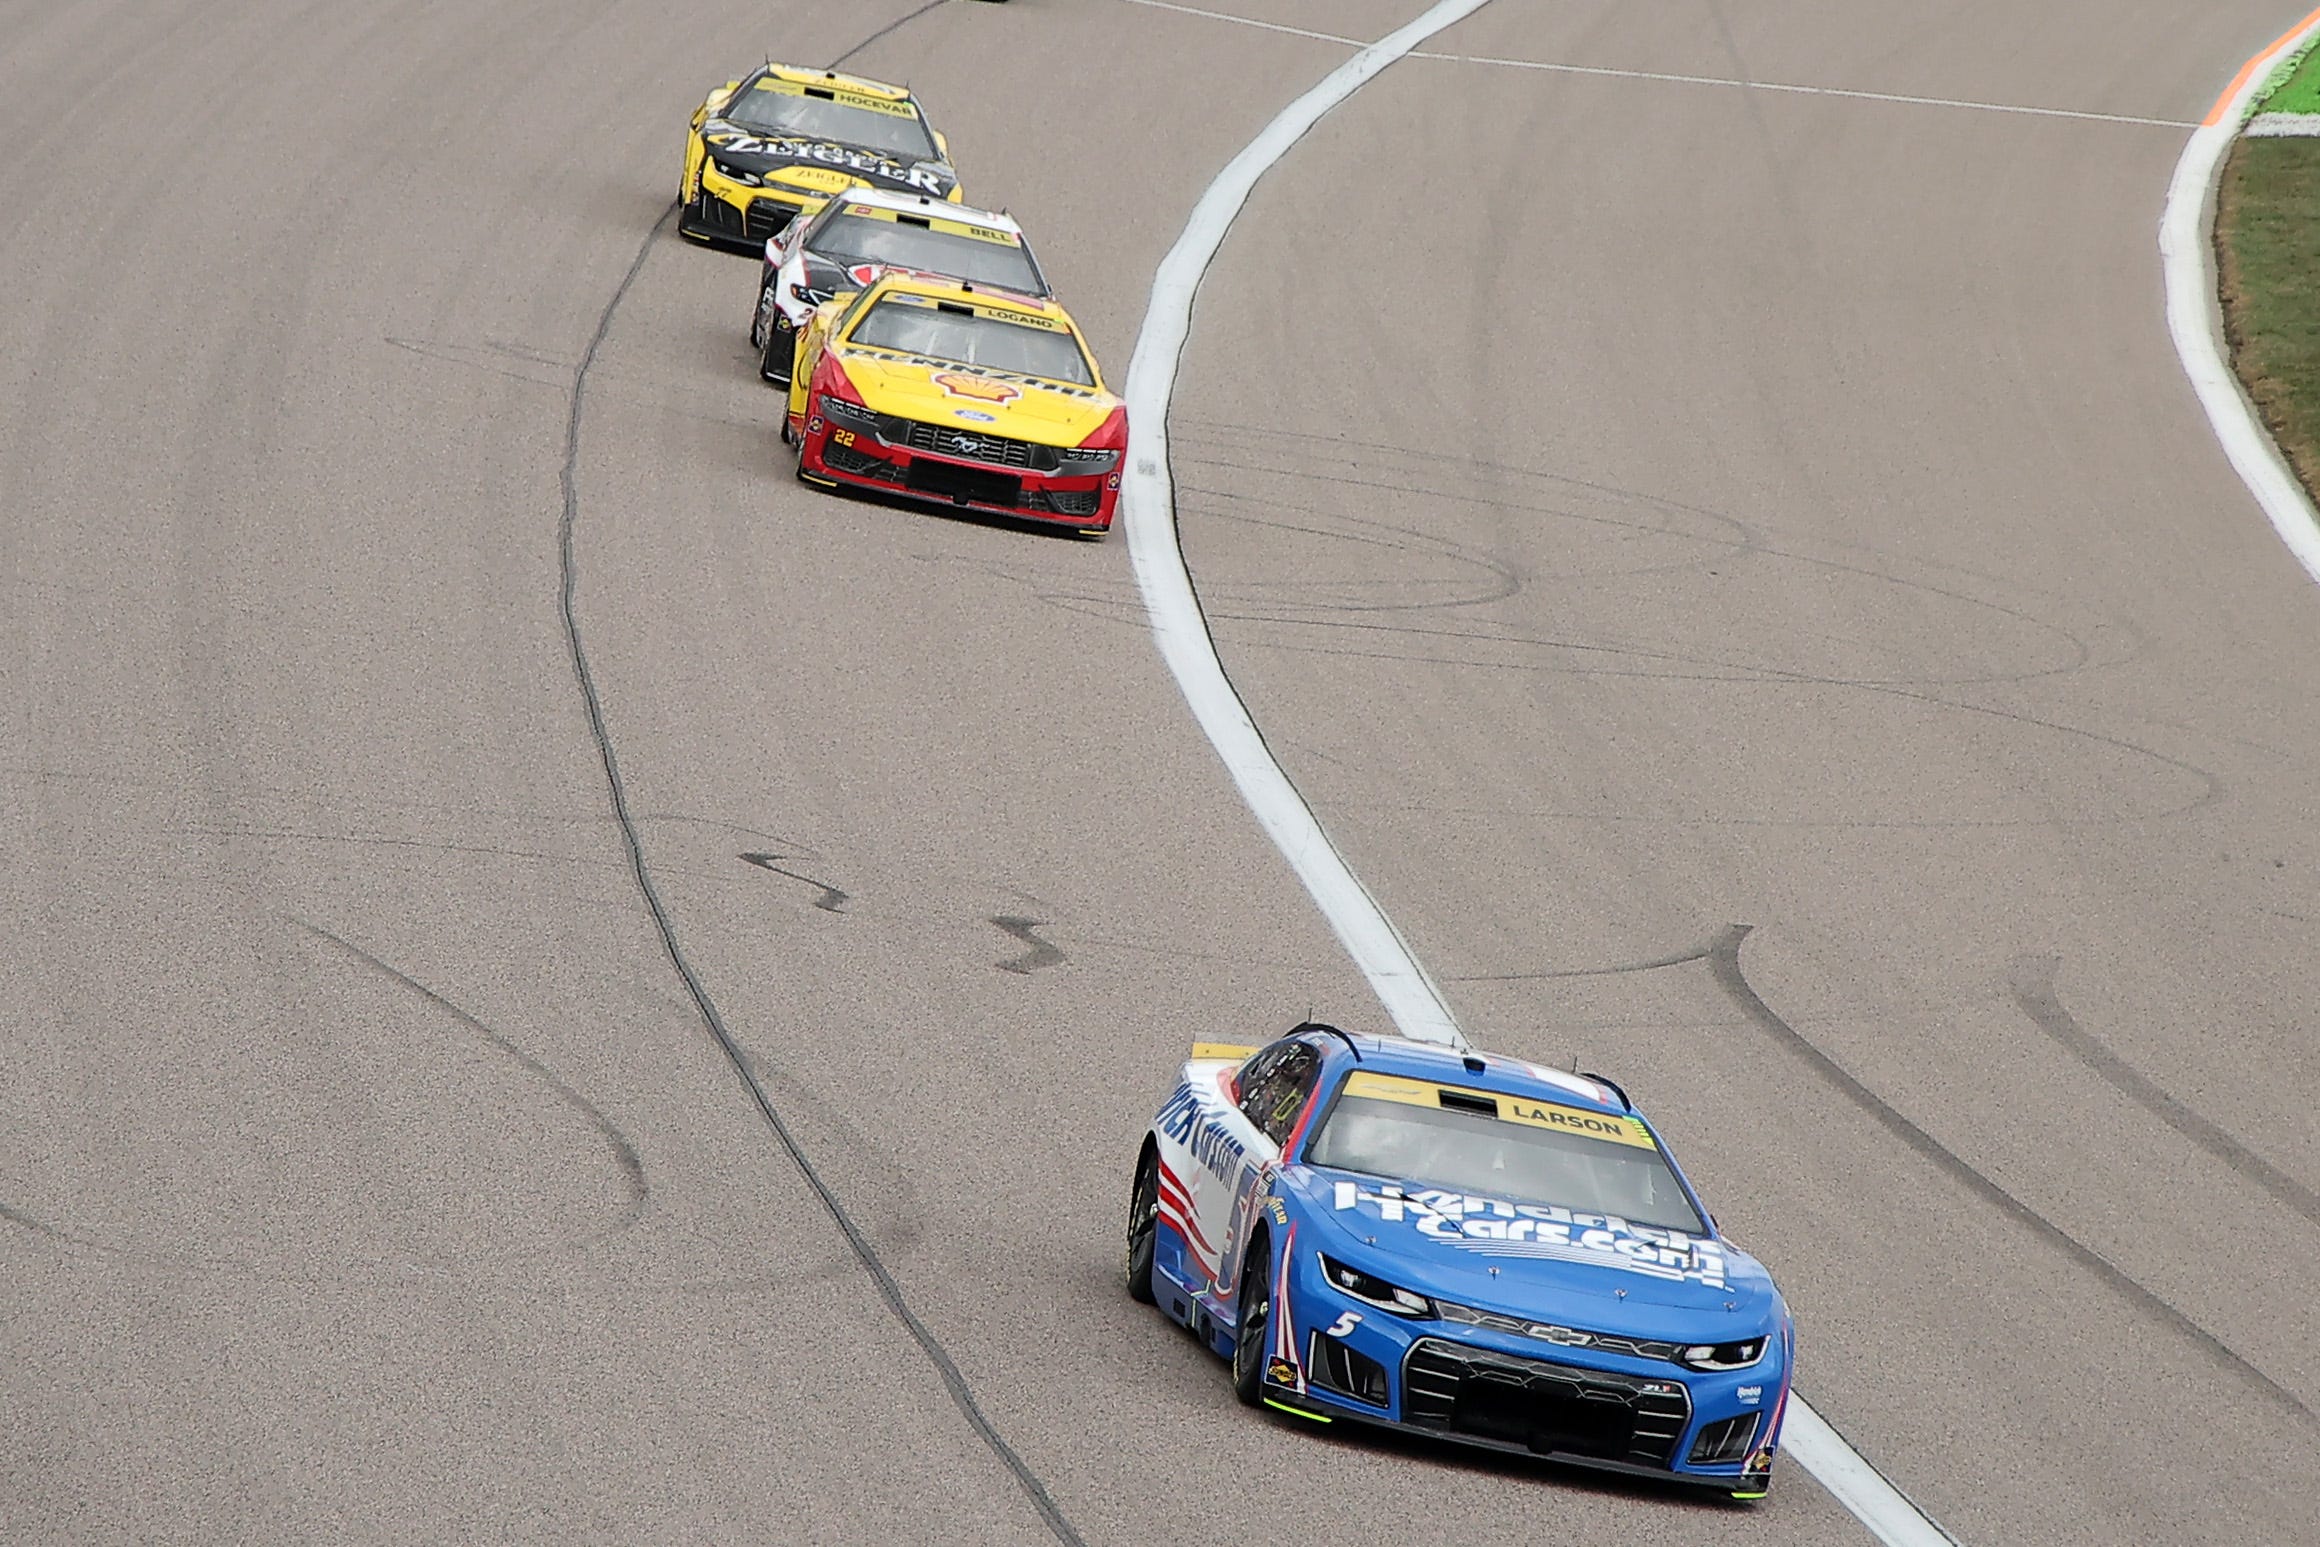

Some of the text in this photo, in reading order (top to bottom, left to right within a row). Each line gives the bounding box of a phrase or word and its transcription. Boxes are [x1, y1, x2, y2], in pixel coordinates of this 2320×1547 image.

[839, 93, 913, 115] HOCEVAR
[725, 136, 942, 197] ZEIGLER
[968, 226, 1011, 243] BELL
[987, 308, 1054, 330] LOGANO
[834, 428, 856, 448] 22
[1513, 1104, 1624, 1138] LARSON
[1326, 1311, 1364, 1338] 5
